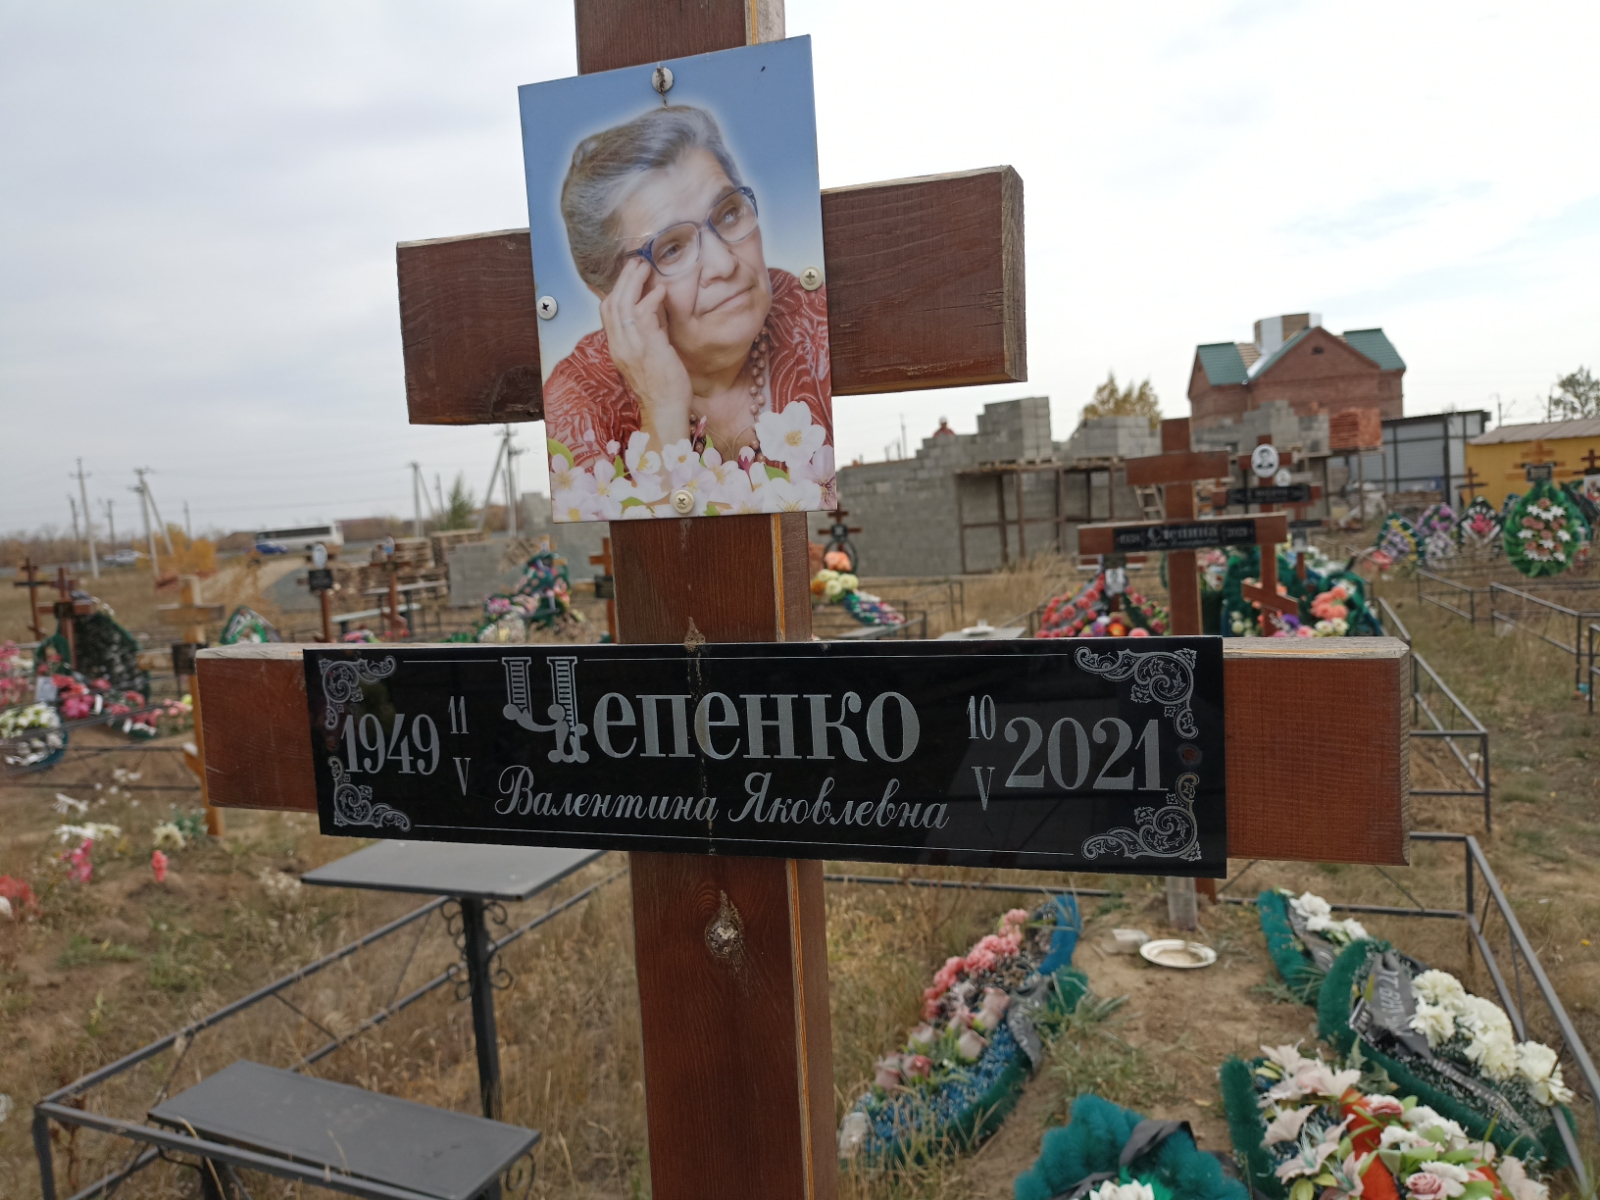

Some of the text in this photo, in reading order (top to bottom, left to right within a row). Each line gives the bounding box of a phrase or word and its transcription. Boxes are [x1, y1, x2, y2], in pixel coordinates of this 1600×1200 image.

[448, 696, 469, 734] 11
[502, 656, 920, 765] Чепенко
[968, 695, 996, 740] 10
[340, 713, 440, 776] 1949
[1004, 716, 1168, 792] 2021
[453, 757, 471, 796] V
[495, 765, 949, 829] Валентина Яковлевна
[973, 767, 995, 811] V
